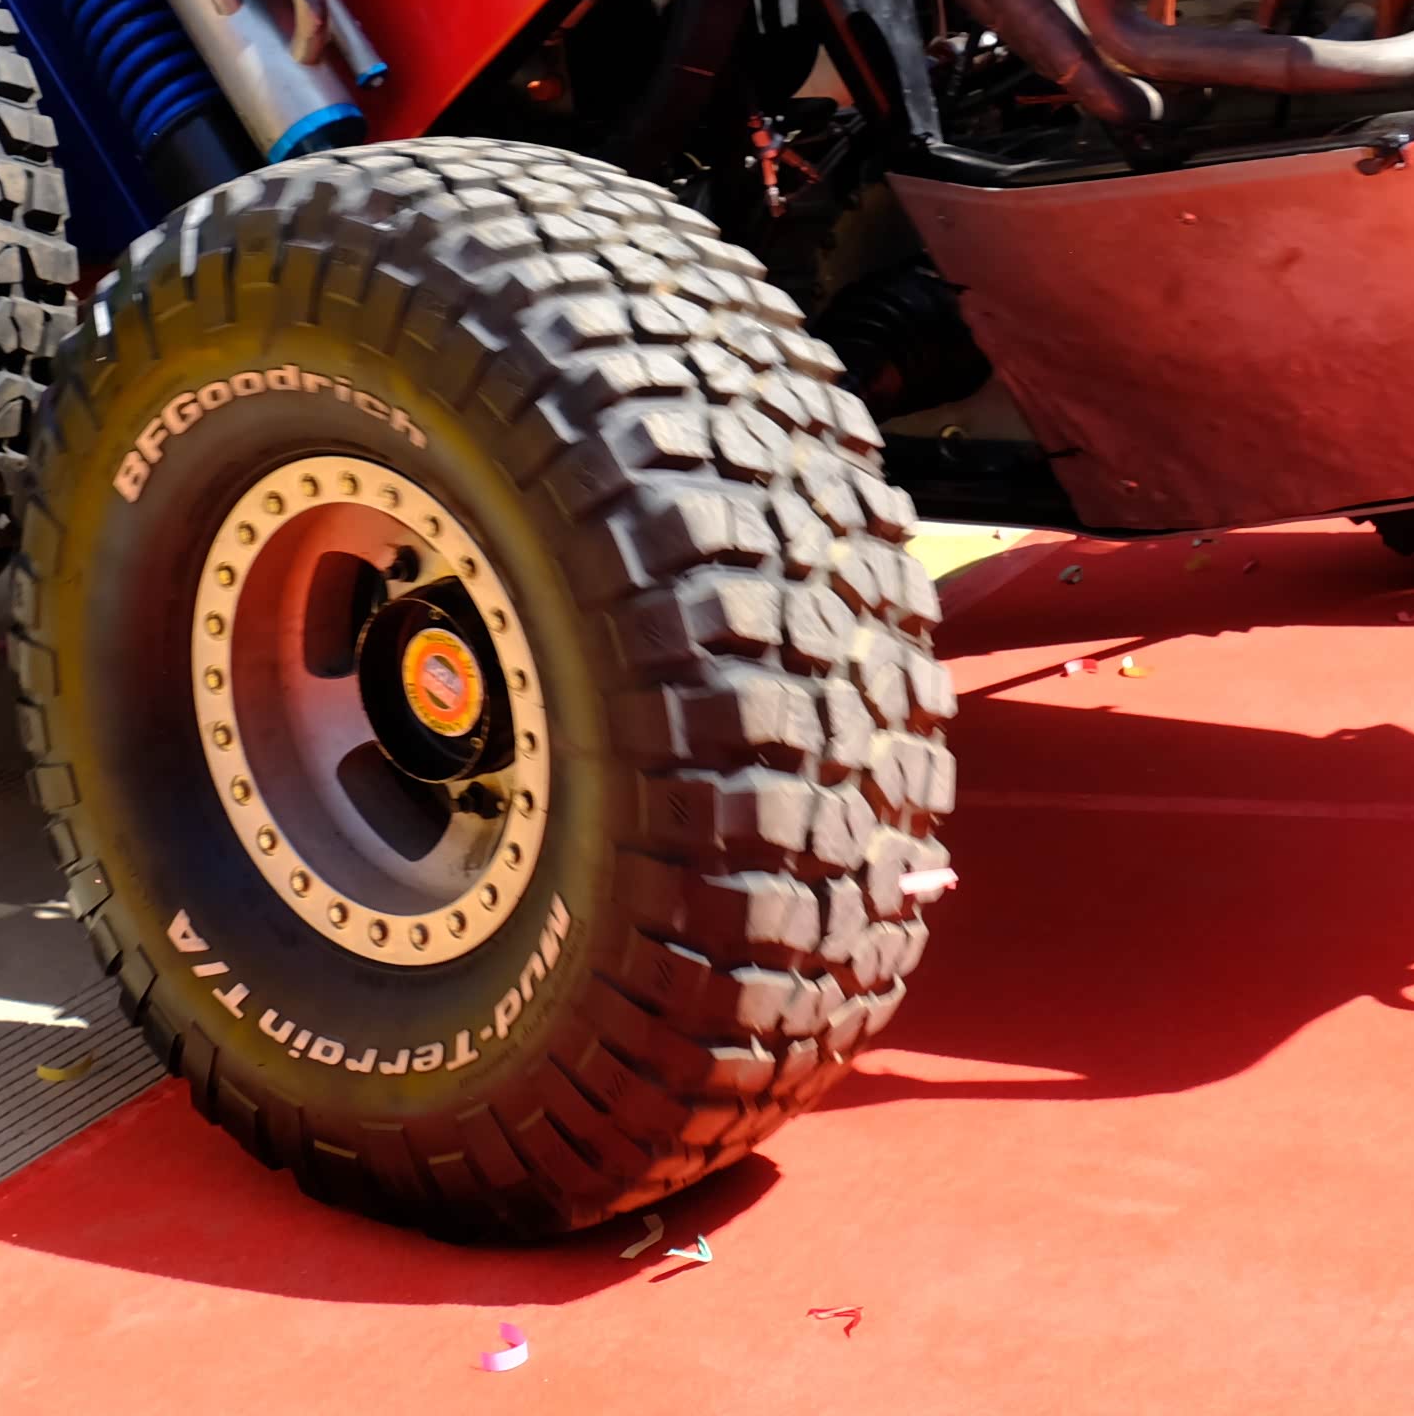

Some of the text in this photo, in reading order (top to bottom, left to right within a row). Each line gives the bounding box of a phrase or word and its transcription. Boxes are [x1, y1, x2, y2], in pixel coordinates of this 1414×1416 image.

[112, 363, 428, 504] BFGoodrich
[167, 908, 251, 1019] T/A
[258, 891, 572, 1075] Mud-Terrain
